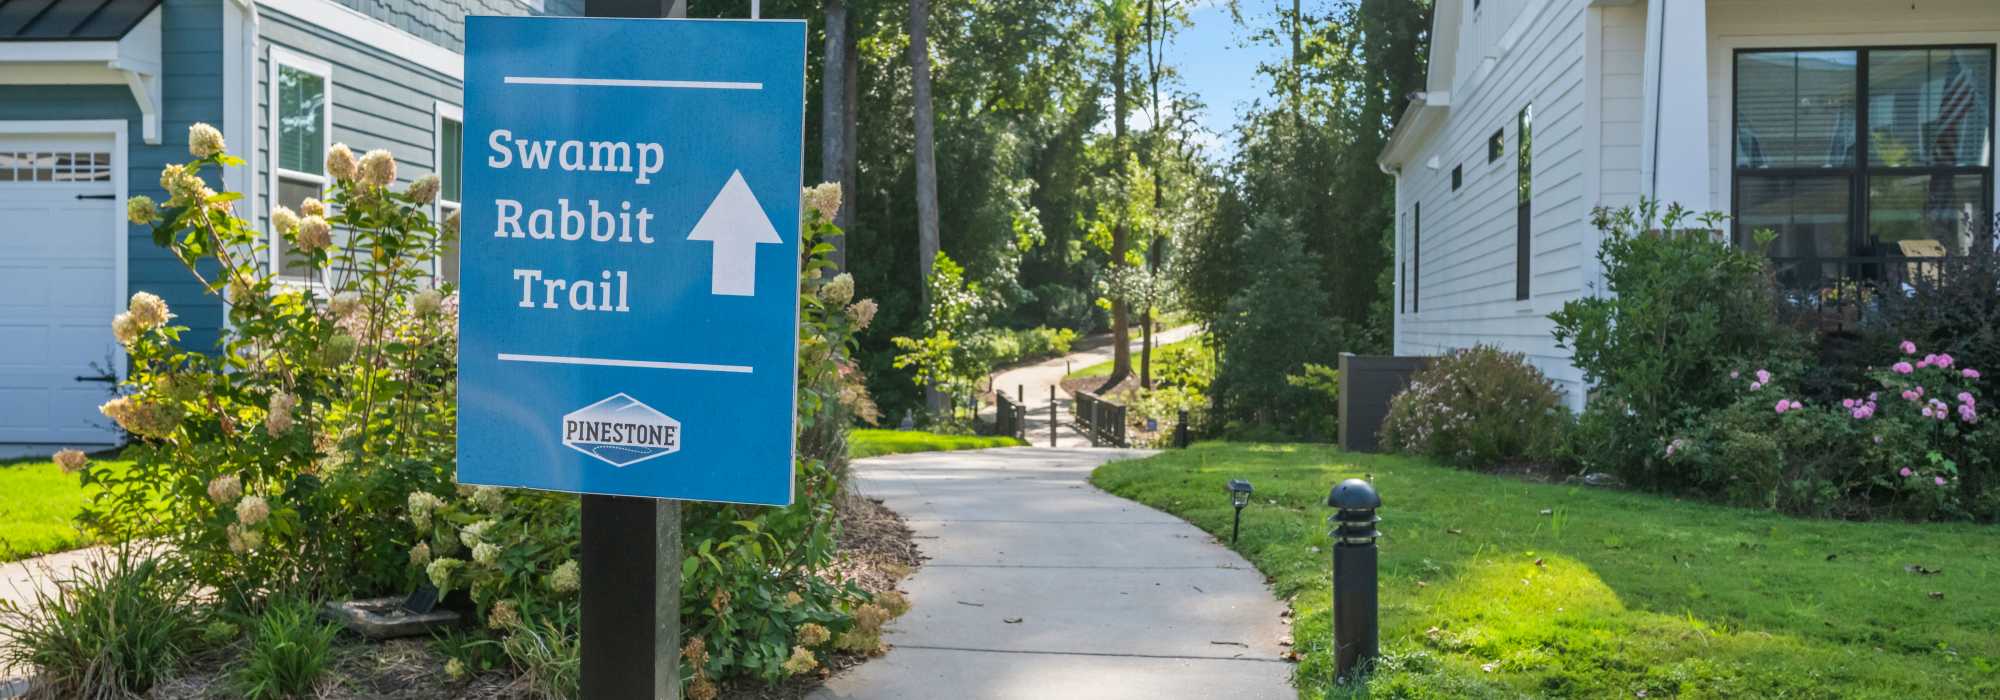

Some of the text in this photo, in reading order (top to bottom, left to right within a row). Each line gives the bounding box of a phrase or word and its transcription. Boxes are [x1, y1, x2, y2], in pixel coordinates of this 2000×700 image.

[488, 129, 664, 185] Swamp
[494, 198, 655, 244] Rabbit
[513, 269, 630, 312] Trail
[566, 420, 676, 446] PINESTONE
